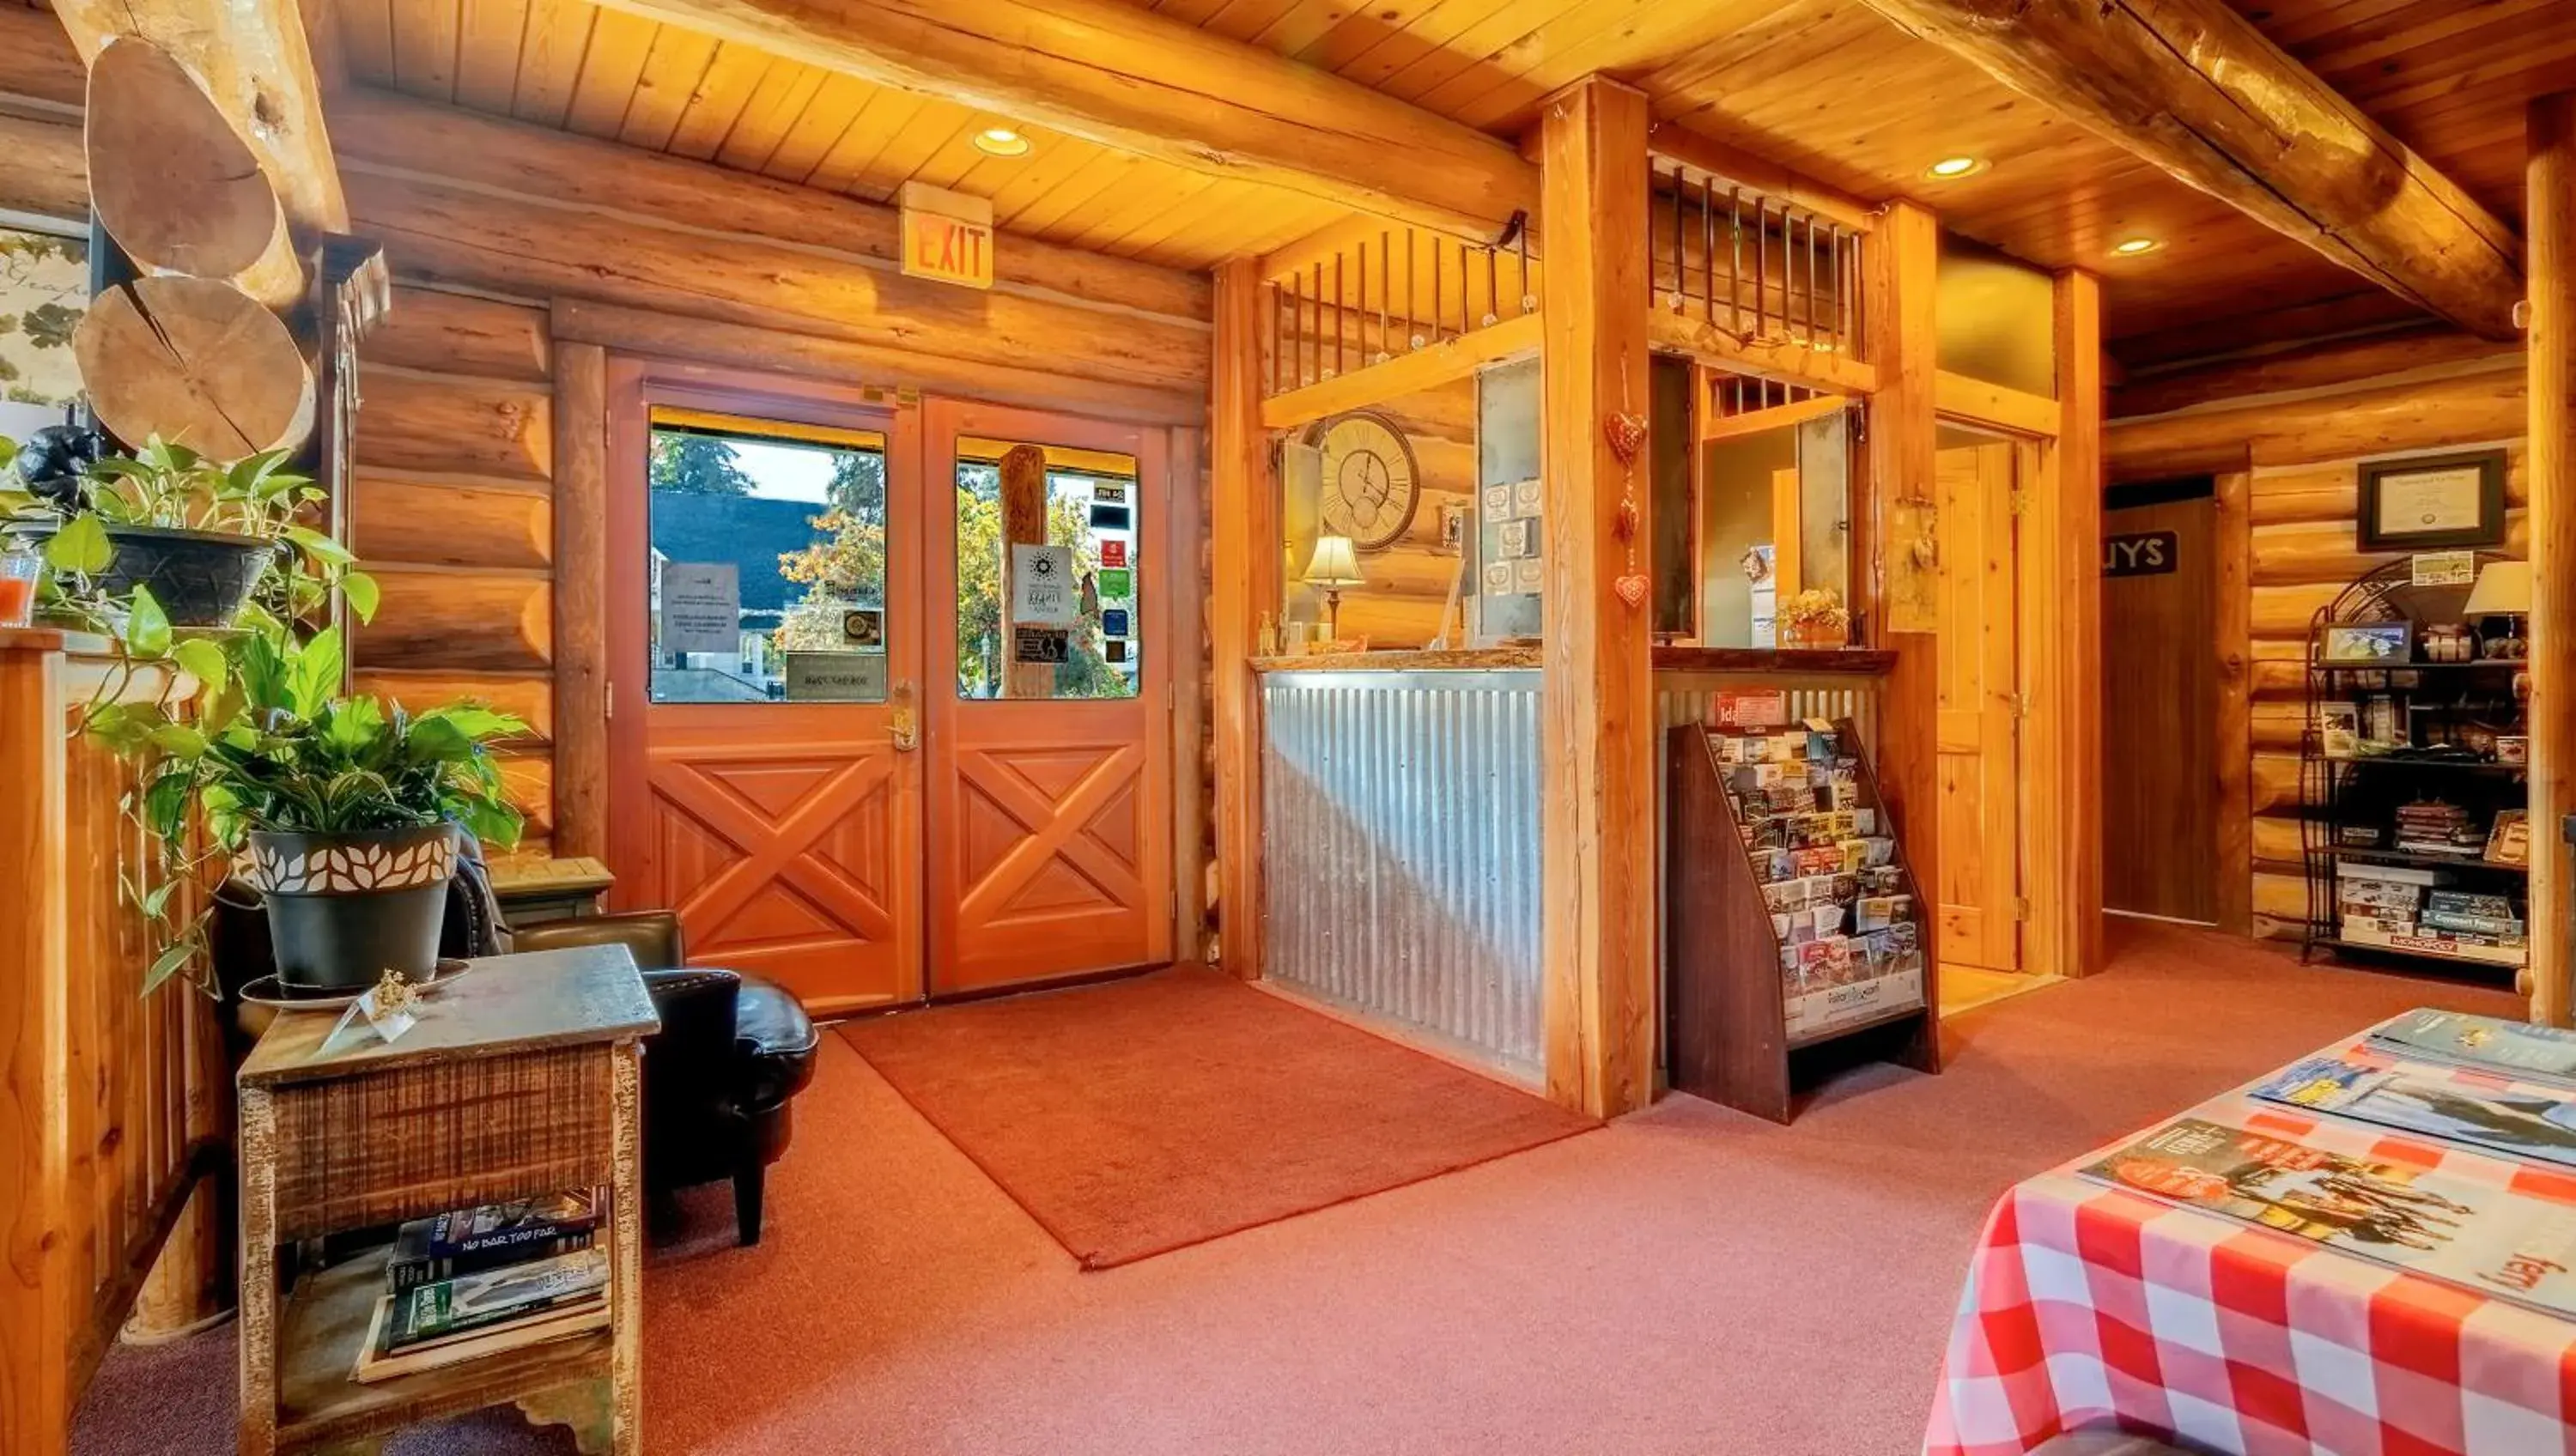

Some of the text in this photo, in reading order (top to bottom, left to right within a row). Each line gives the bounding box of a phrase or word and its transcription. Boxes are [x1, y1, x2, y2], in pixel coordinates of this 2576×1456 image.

[916, 215, 986, 276] EXIT
[2392, 937, 2454, 951] MONOPOLY
[462, 1226, 557, 1251] NO BAR TOO FAR
